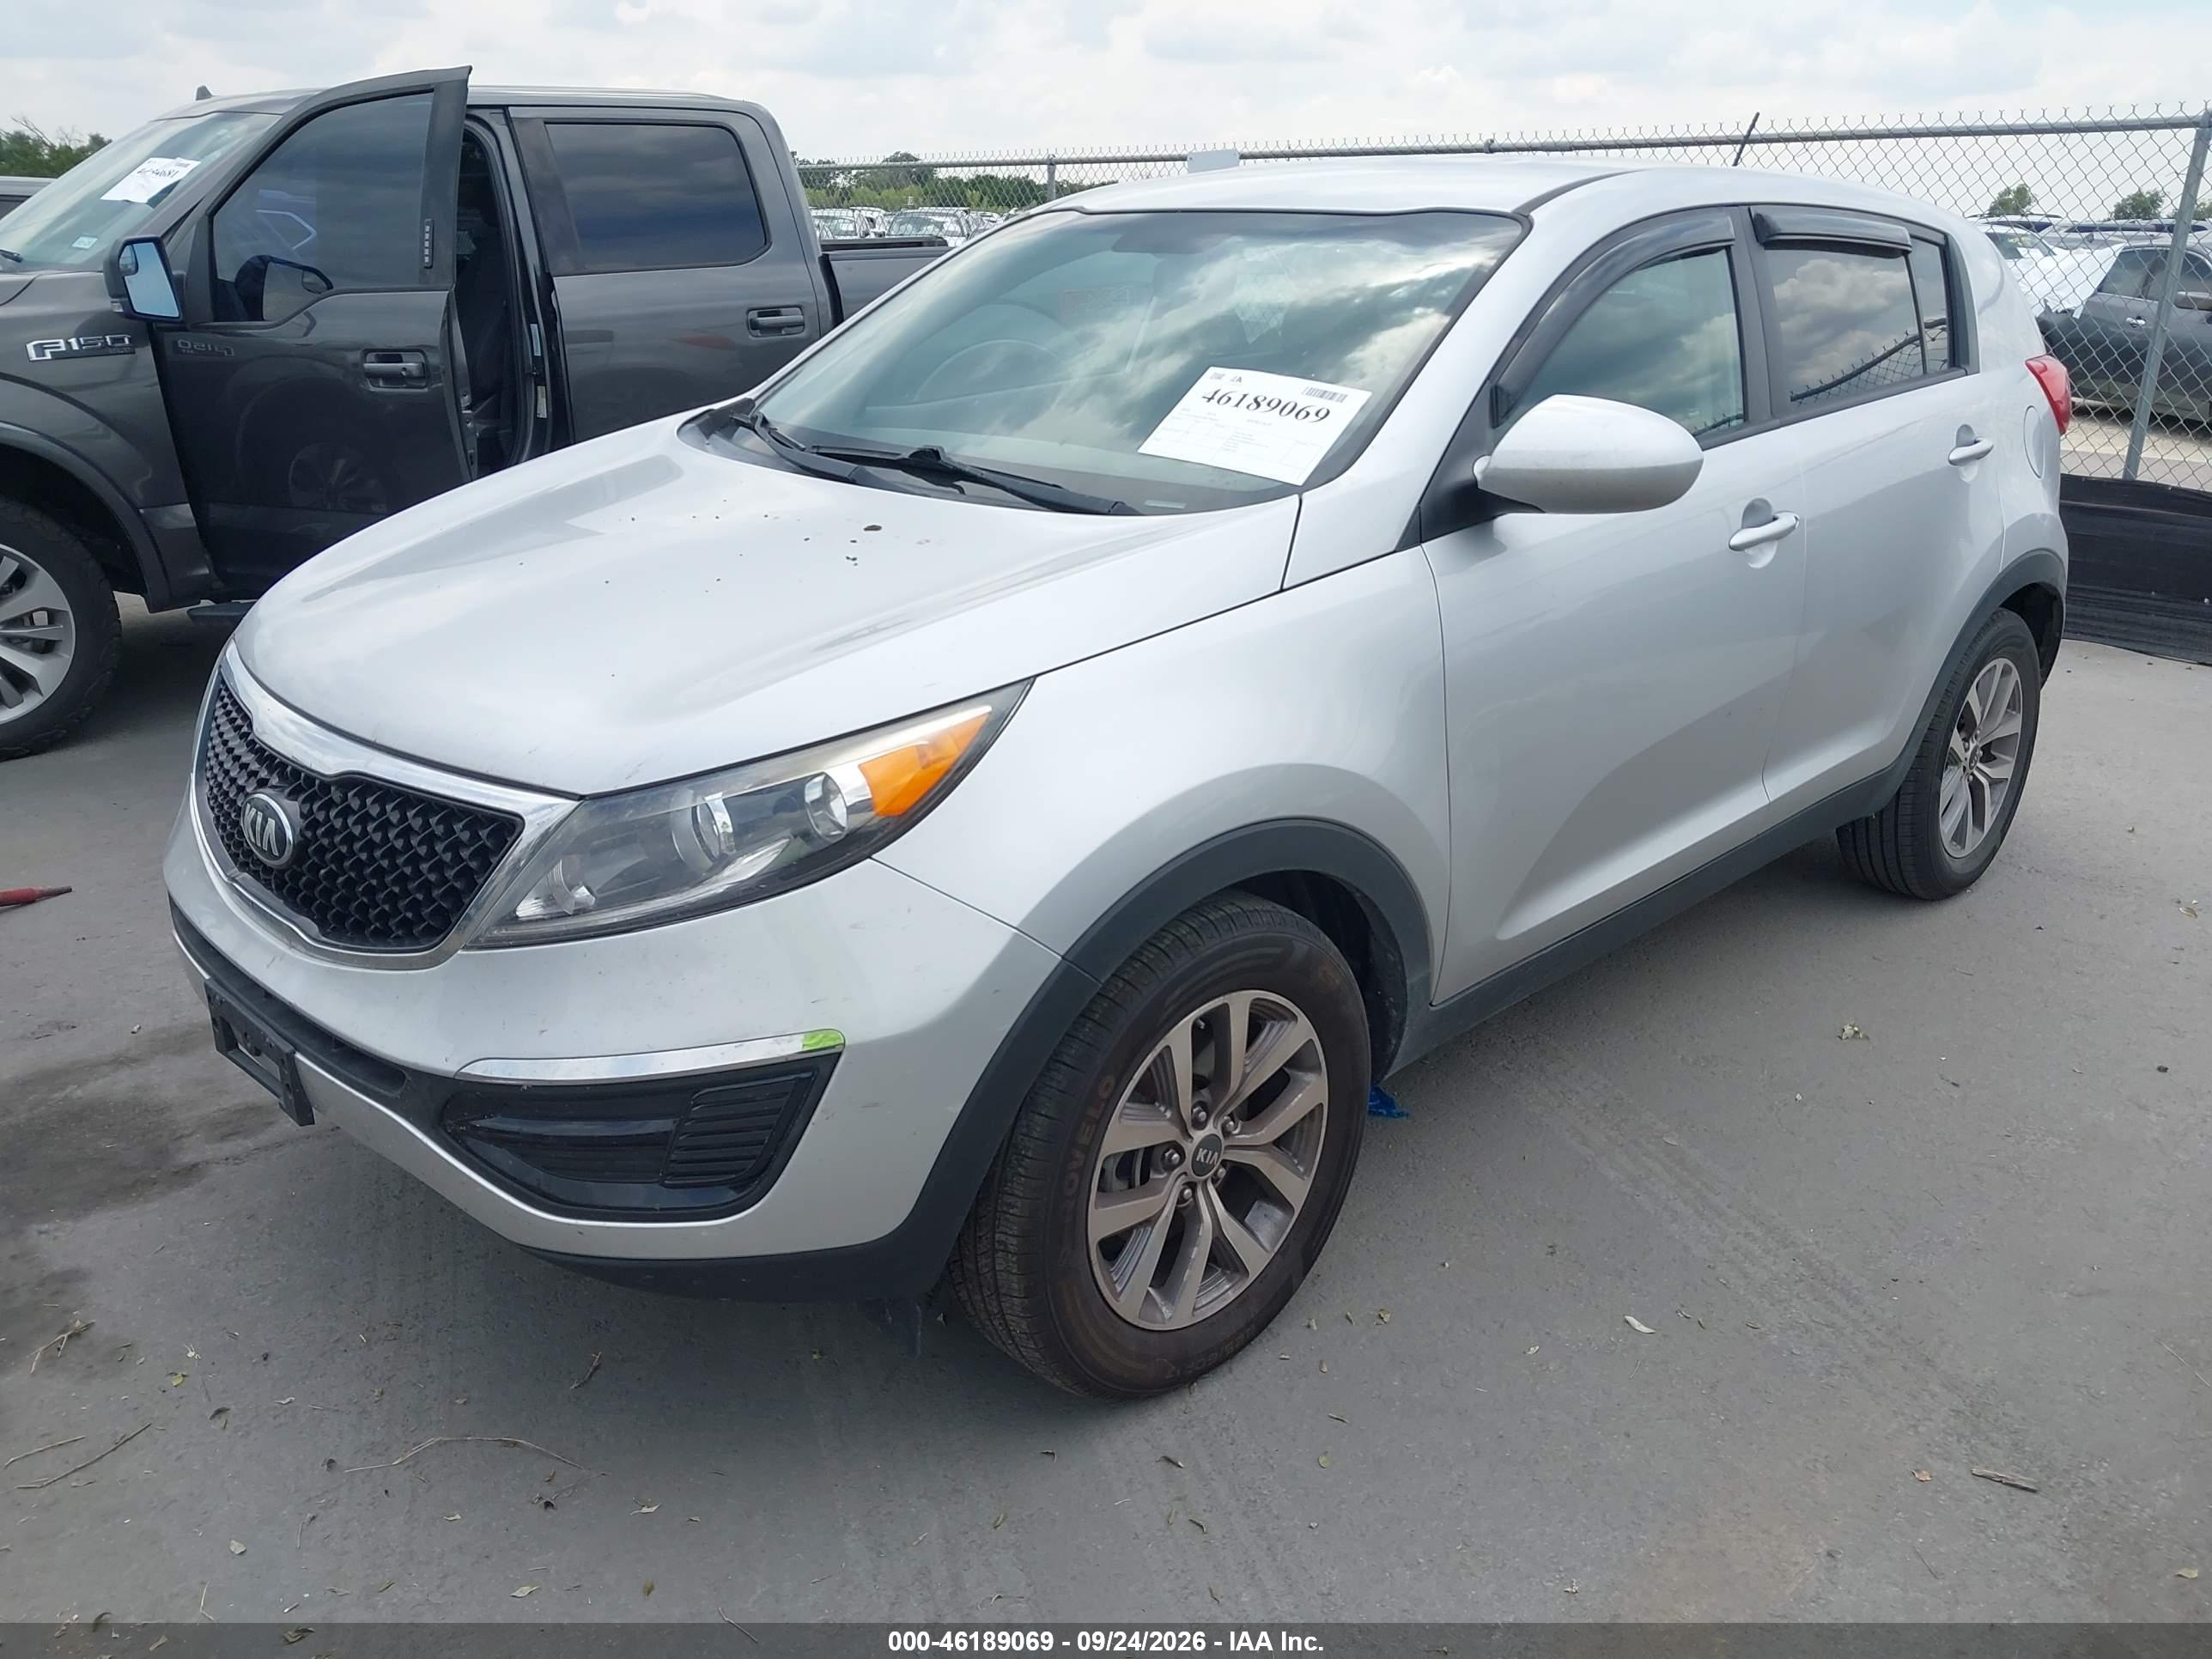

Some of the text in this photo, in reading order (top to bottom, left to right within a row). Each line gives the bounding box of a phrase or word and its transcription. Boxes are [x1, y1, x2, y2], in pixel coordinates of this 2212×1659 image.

[26, 334, 131, 361] F150
[1201, 388, 1331, 423] 46189069
[244, 802, 279, 857] KIA
[1195, 1147, 1218, 1165] KIA
